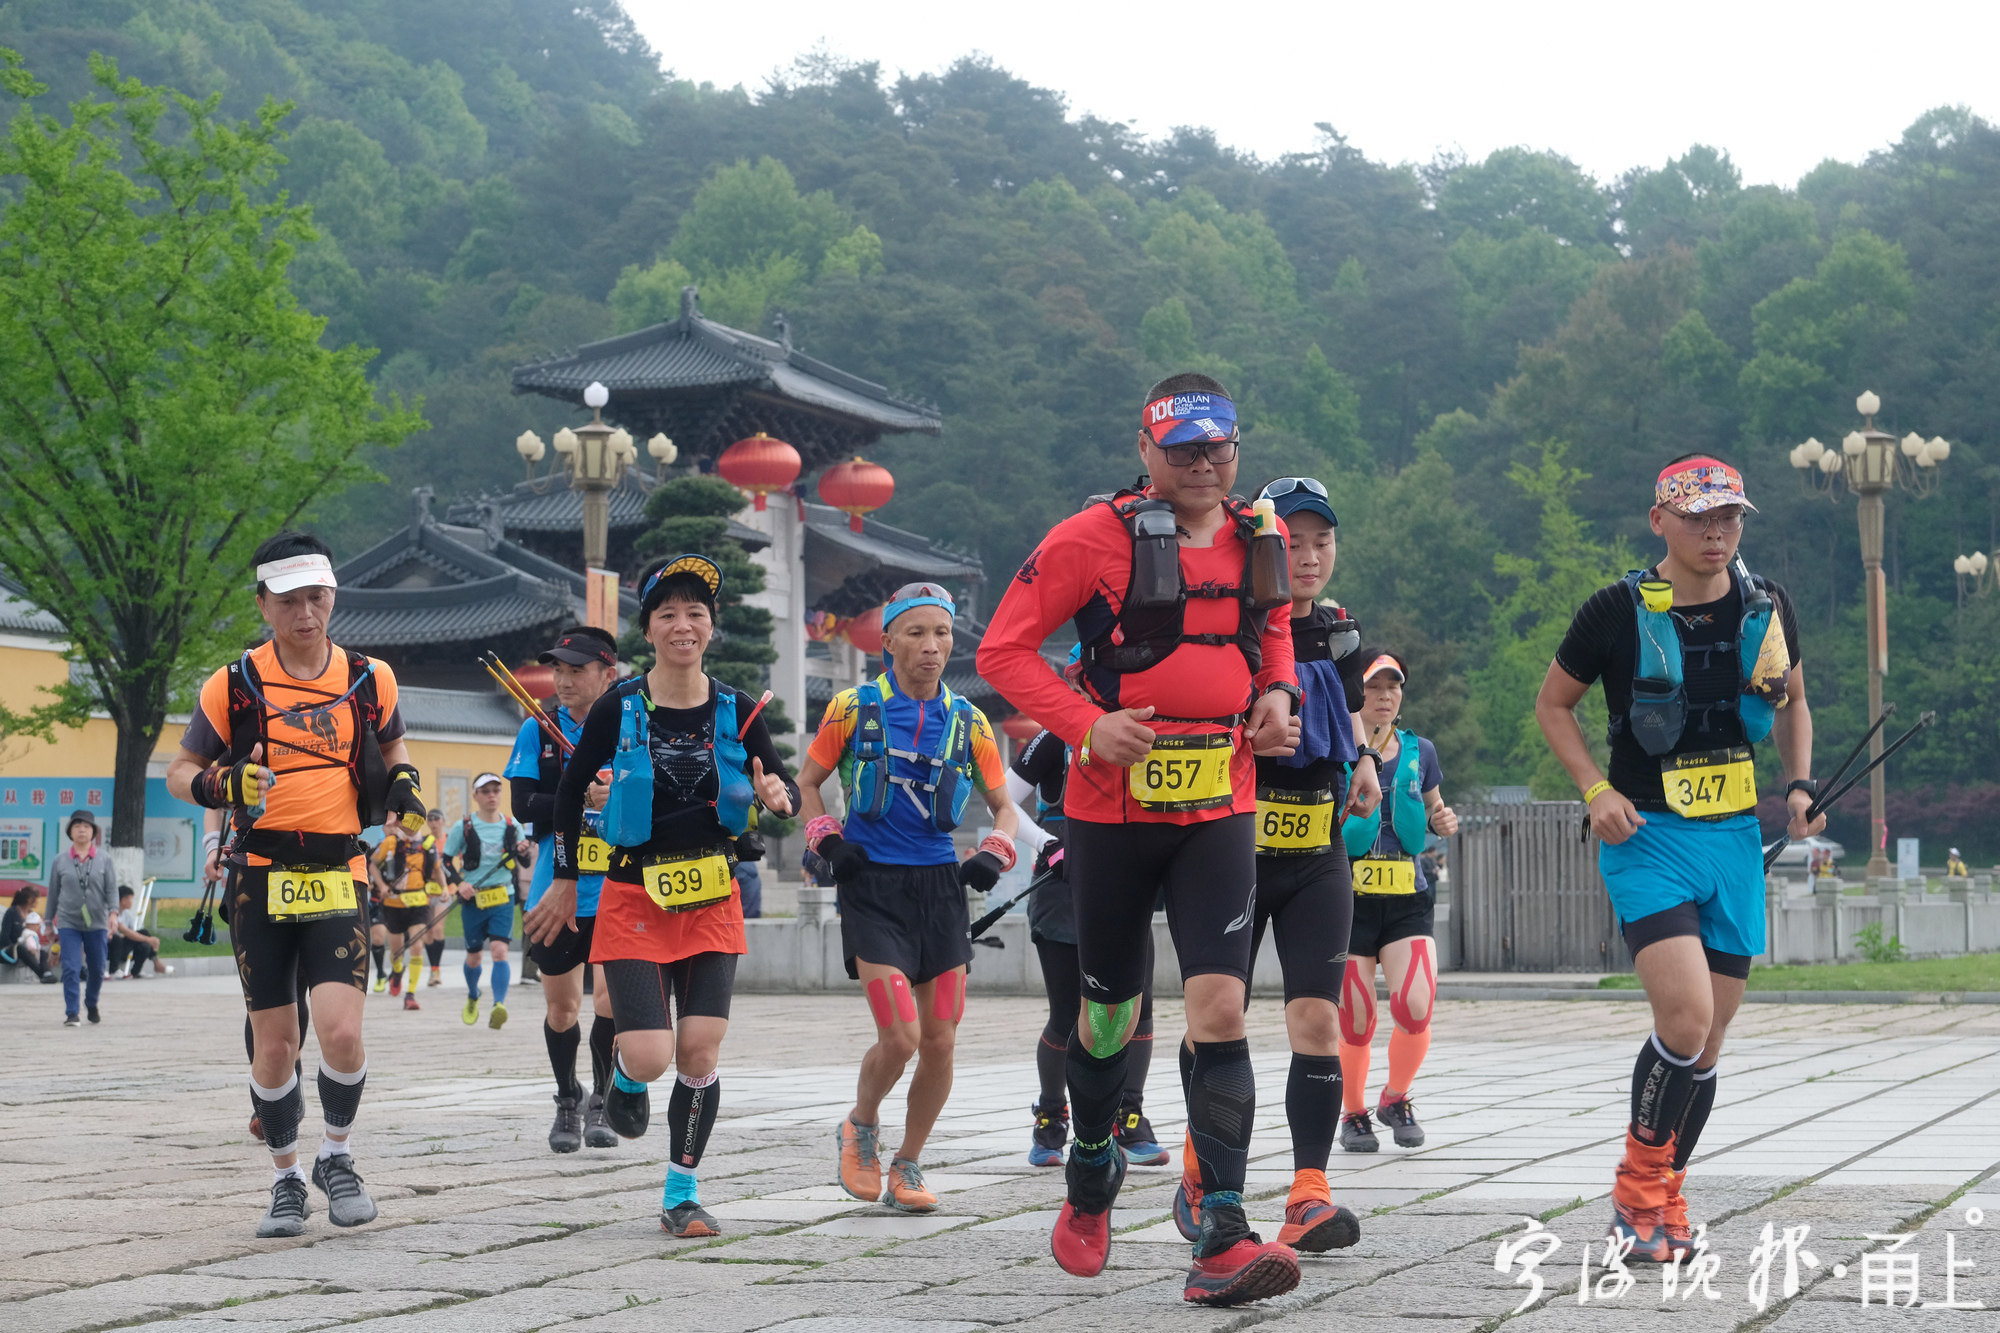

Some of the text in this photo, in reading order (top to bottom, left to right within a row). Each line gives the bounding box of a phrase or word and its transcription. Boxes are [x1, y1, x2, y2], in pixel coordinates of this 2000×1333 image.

[1174, 395, 1210, 406] DALIAN
[1146, 759, 1202, 790] 657
[4, 788, 103, 806] 从我做起
[1677, 774, 1727, 807] 347
[1263, 811, 1311, 839] 658
[657, 867, 703, 897] 639
[1362, 866, 1394, 886] 211
[281, 879, 326, 904] 640
